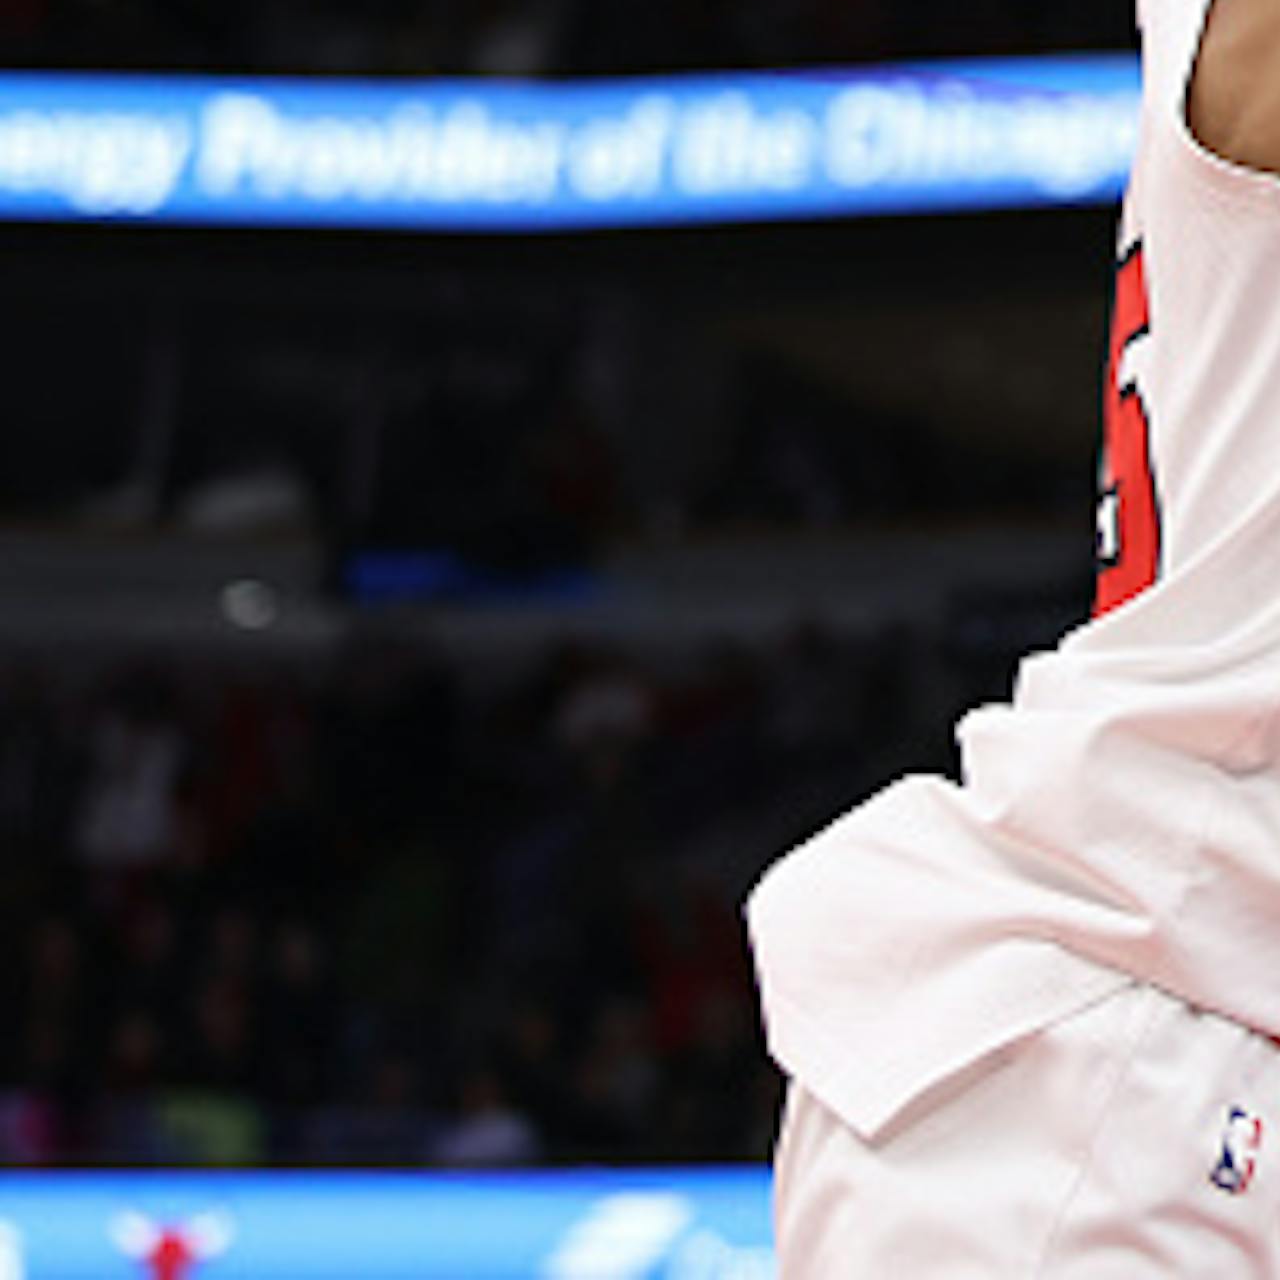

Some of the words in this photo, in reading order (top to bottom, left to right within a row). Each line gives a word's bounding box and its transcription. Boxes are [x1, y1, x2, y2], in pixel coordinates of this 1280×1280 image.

[0, 108, 192, 216] ergy
[200, 88, 563, 204] Provider
[567, 94, 674, 202] of
[672, 88, 814, 196] the
